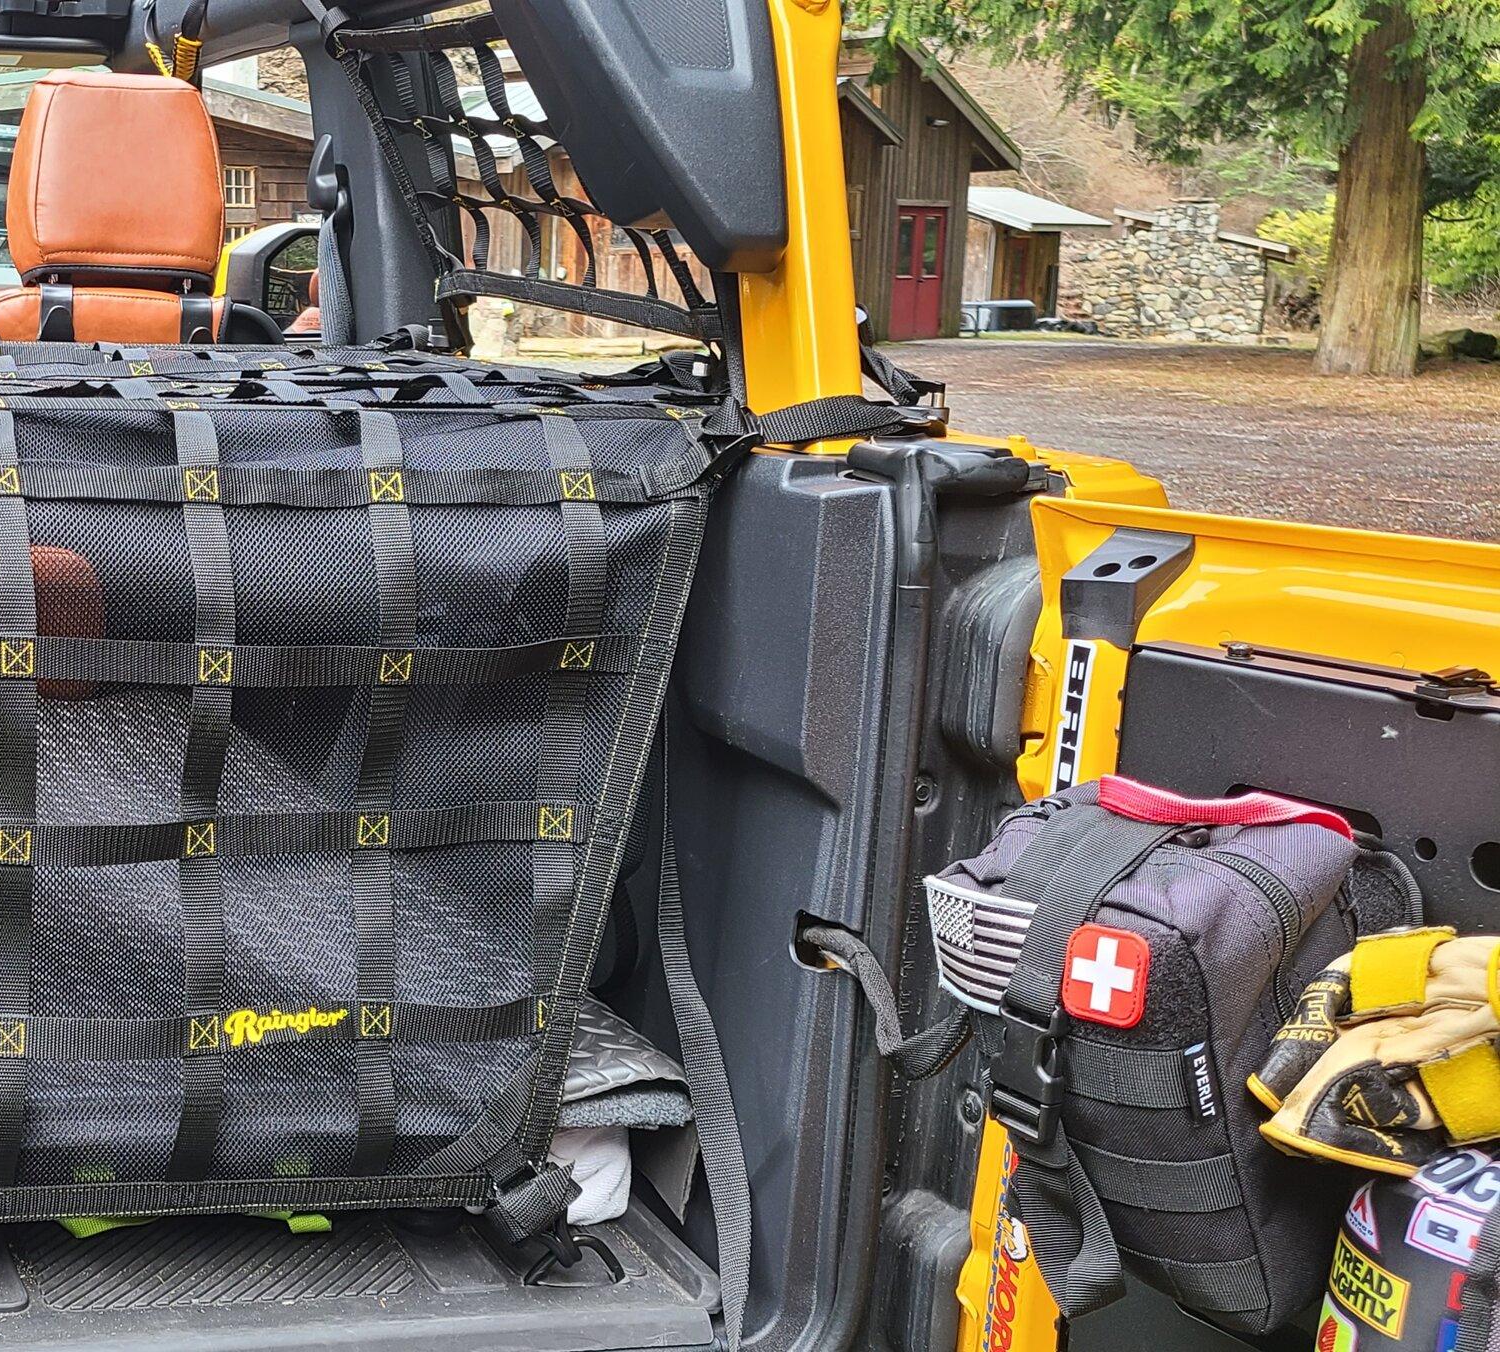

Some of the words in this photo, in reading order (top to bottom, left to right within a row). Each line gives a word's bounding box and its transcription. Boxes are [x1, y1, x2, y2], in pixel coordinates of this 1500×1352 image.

[1193, 1055, 1216, 1116] EVERLIT
[990, 1250, 1020, 1352] HOR
[1338, 1242, 1393, 1299] TREAD
